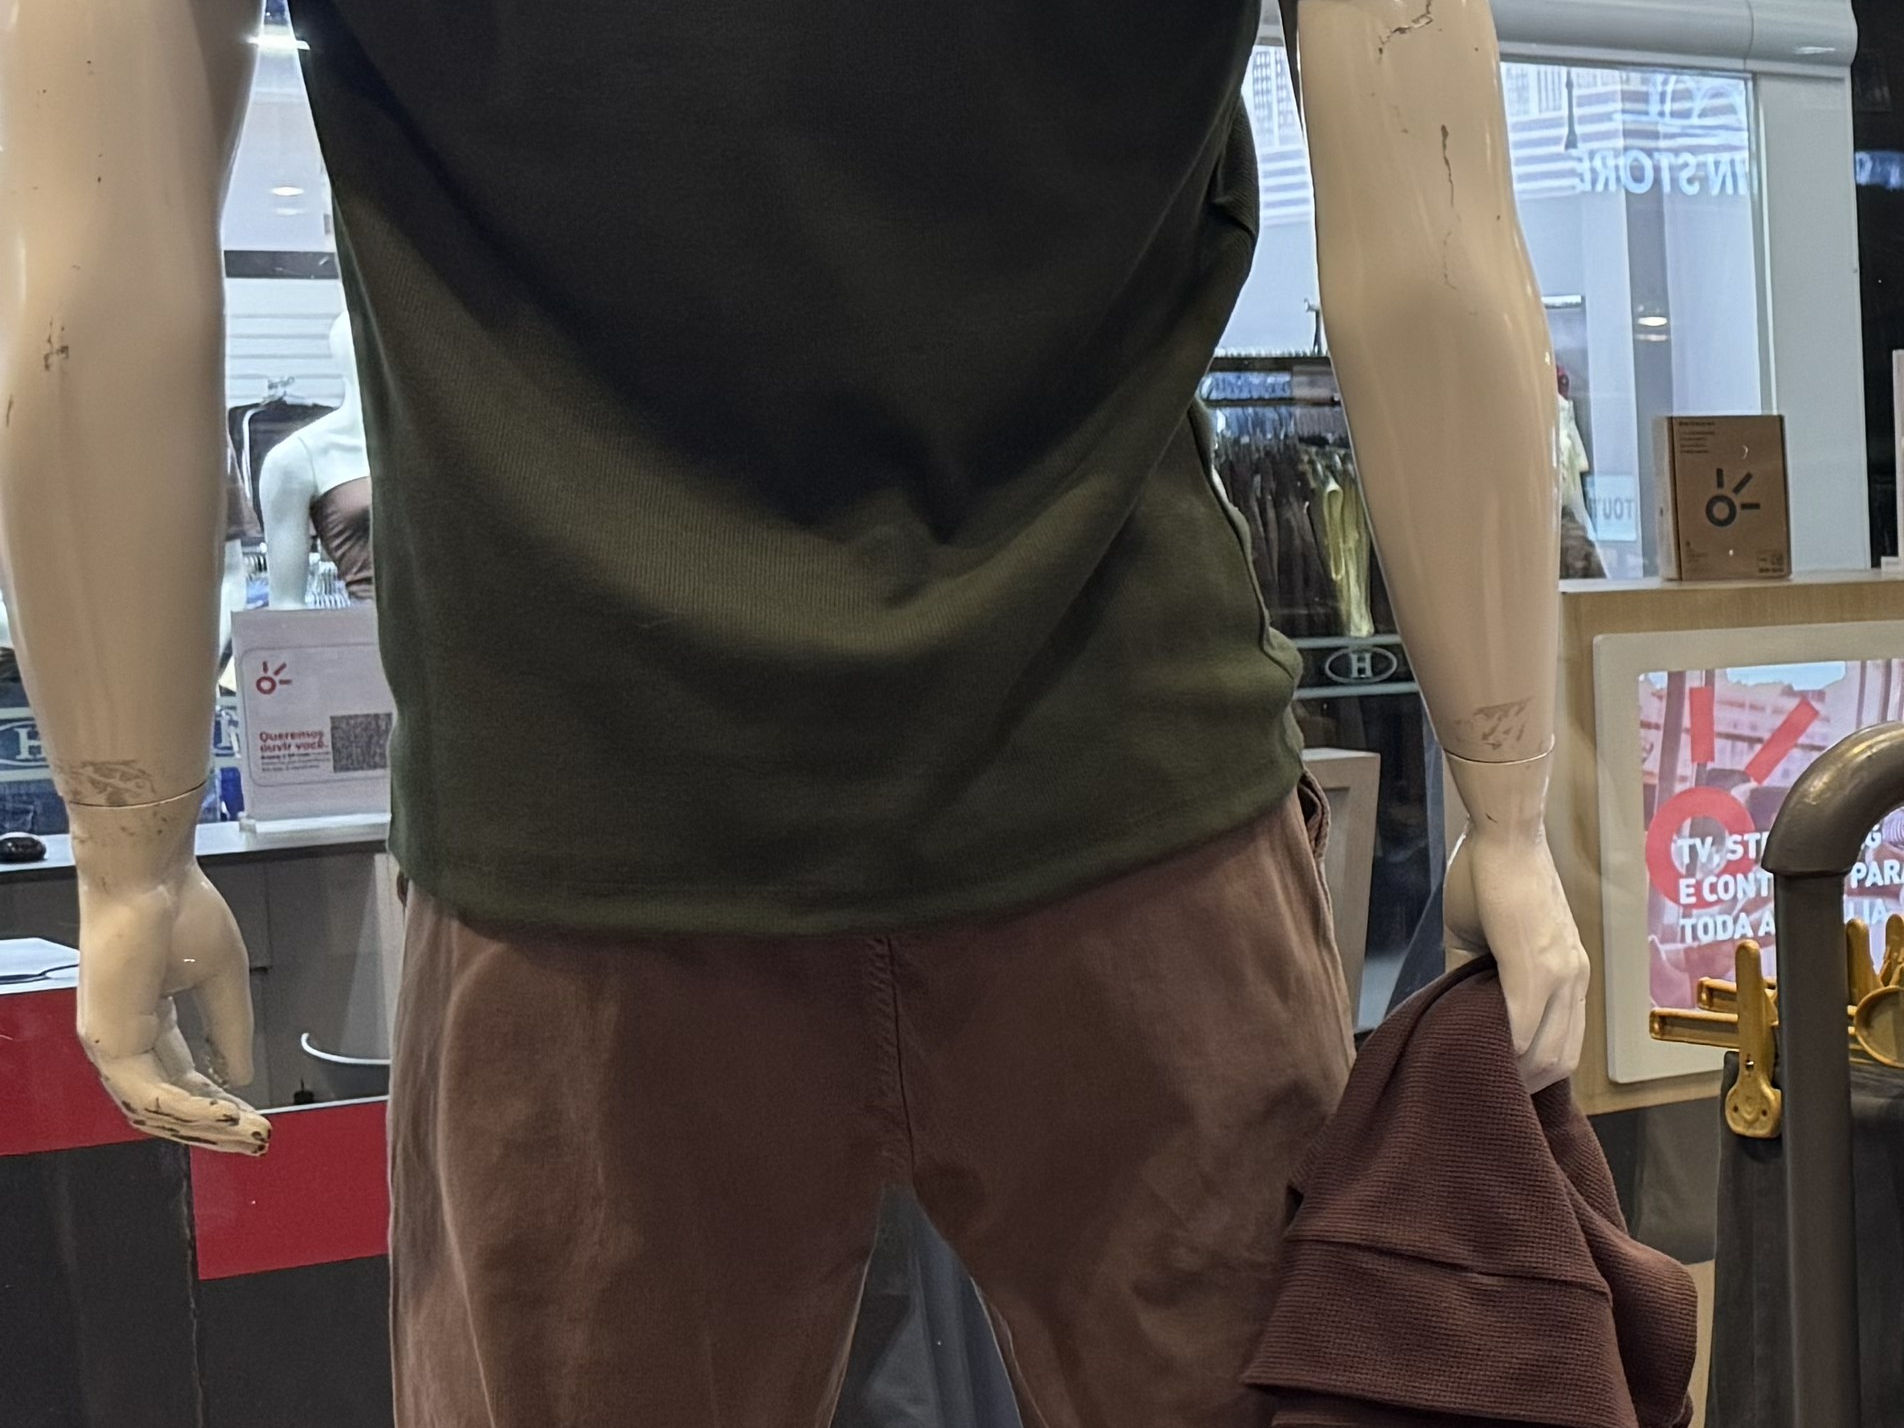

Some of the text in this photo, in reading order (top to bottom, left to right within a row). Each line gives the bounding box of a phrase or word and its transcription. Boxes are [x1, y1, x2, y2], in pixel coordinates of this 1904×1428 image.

[1677, 836, 1721, 867] TV,
[1679, 878, 1697, 904] E
[1703, 873, 1772, 901] CONT
[1678, 912, 1754, 944] TODA
